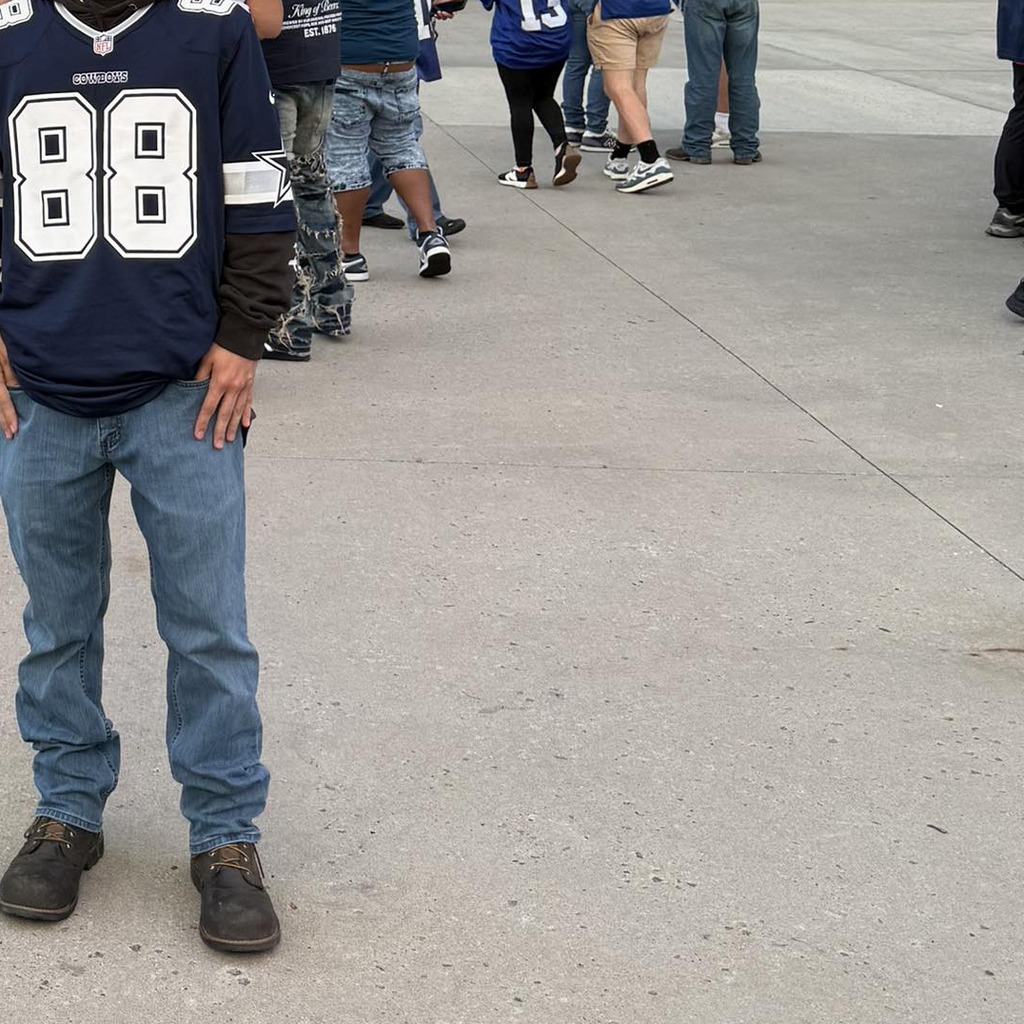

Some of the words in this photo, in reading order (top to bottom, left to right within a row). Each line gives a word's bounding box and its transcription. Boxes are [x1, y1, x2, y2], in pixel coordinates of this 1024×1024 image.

[287, 3, 312, 19] King
[304, 26, 321, 38] EST.
[321, 23, 337, 36] 1876
[72, 71, 128, 85] COWBOYS
[8, 88, 197, 262] 88
